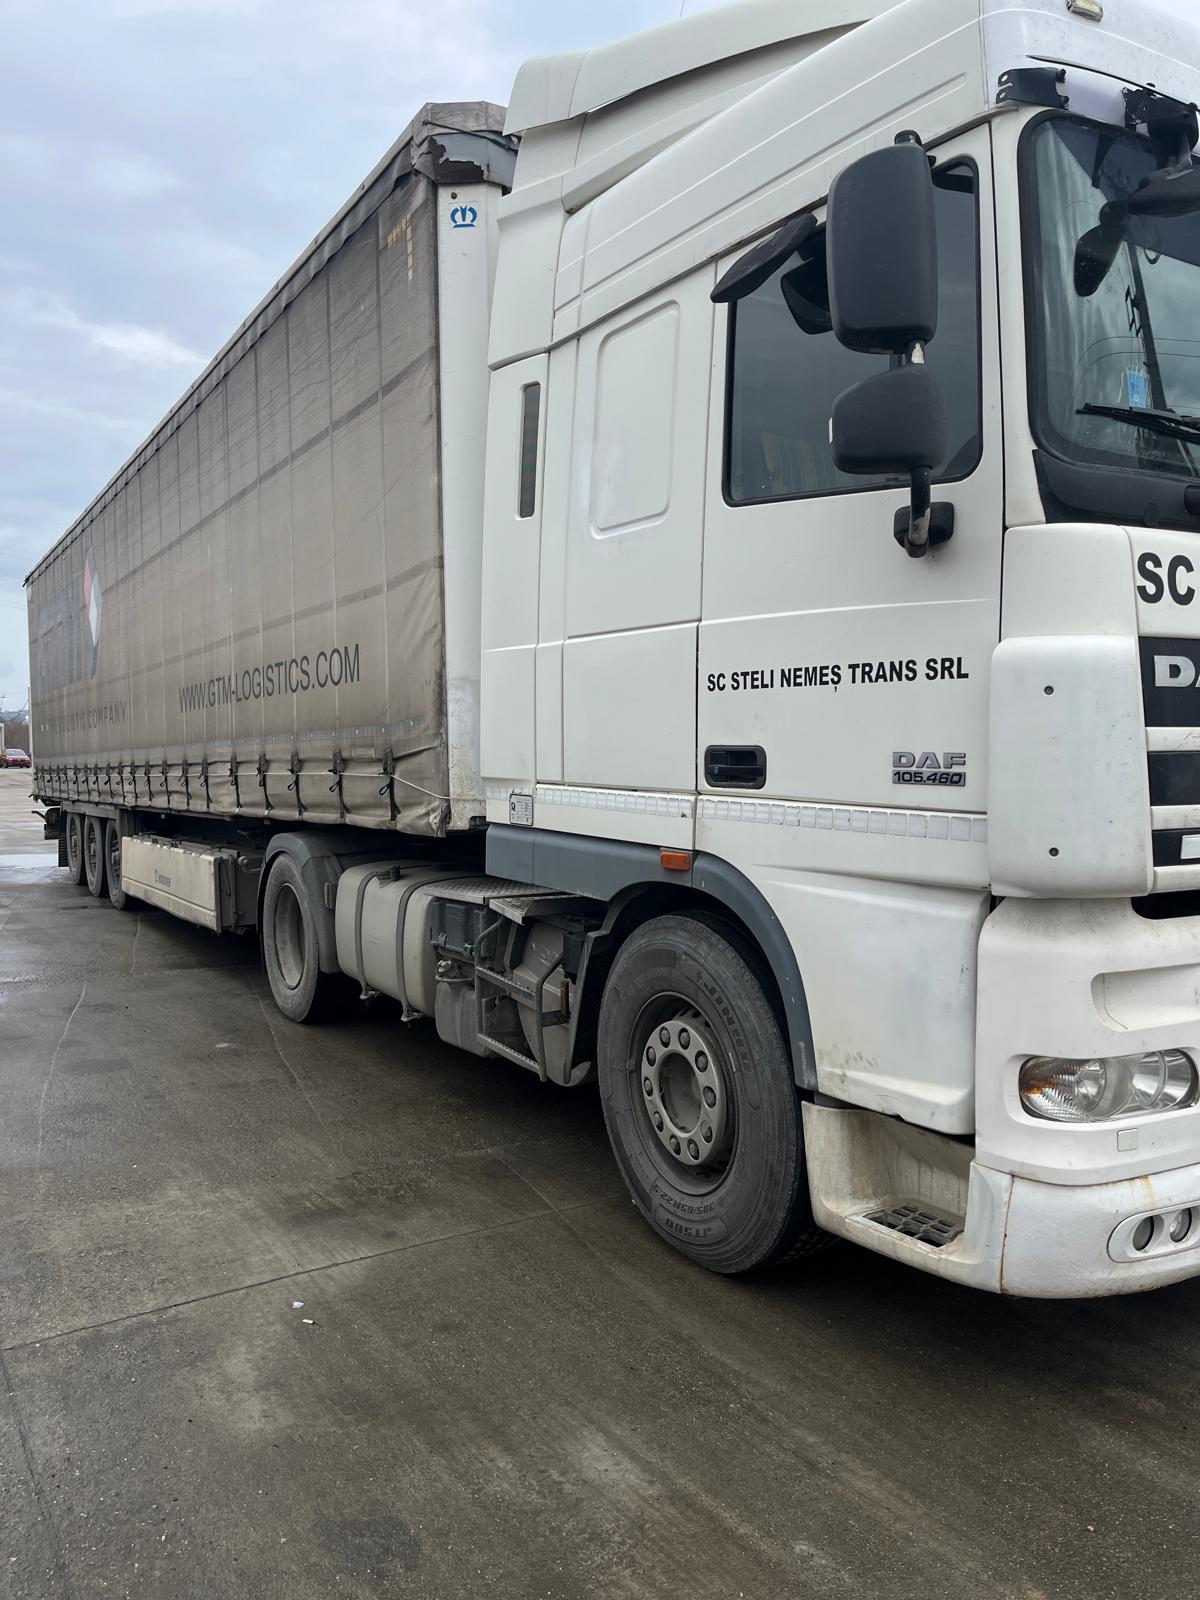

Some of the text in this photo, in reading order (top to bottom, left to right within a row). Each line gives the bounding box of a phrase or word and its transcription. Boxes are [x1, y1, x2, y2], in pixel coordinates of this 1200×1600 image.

[1137, 552, 1196, 606] SC
[179, 643, 360, 713] WWW.GTM-LOGISTICS.COM
[707, 657, 969, 693] SC STELI NEMEȘ TRANS SRL
[88, 701, 127, 729] COMPANY
[892, 751, 966, 769] DAF
[893, 771, 964, 786] 105.460
